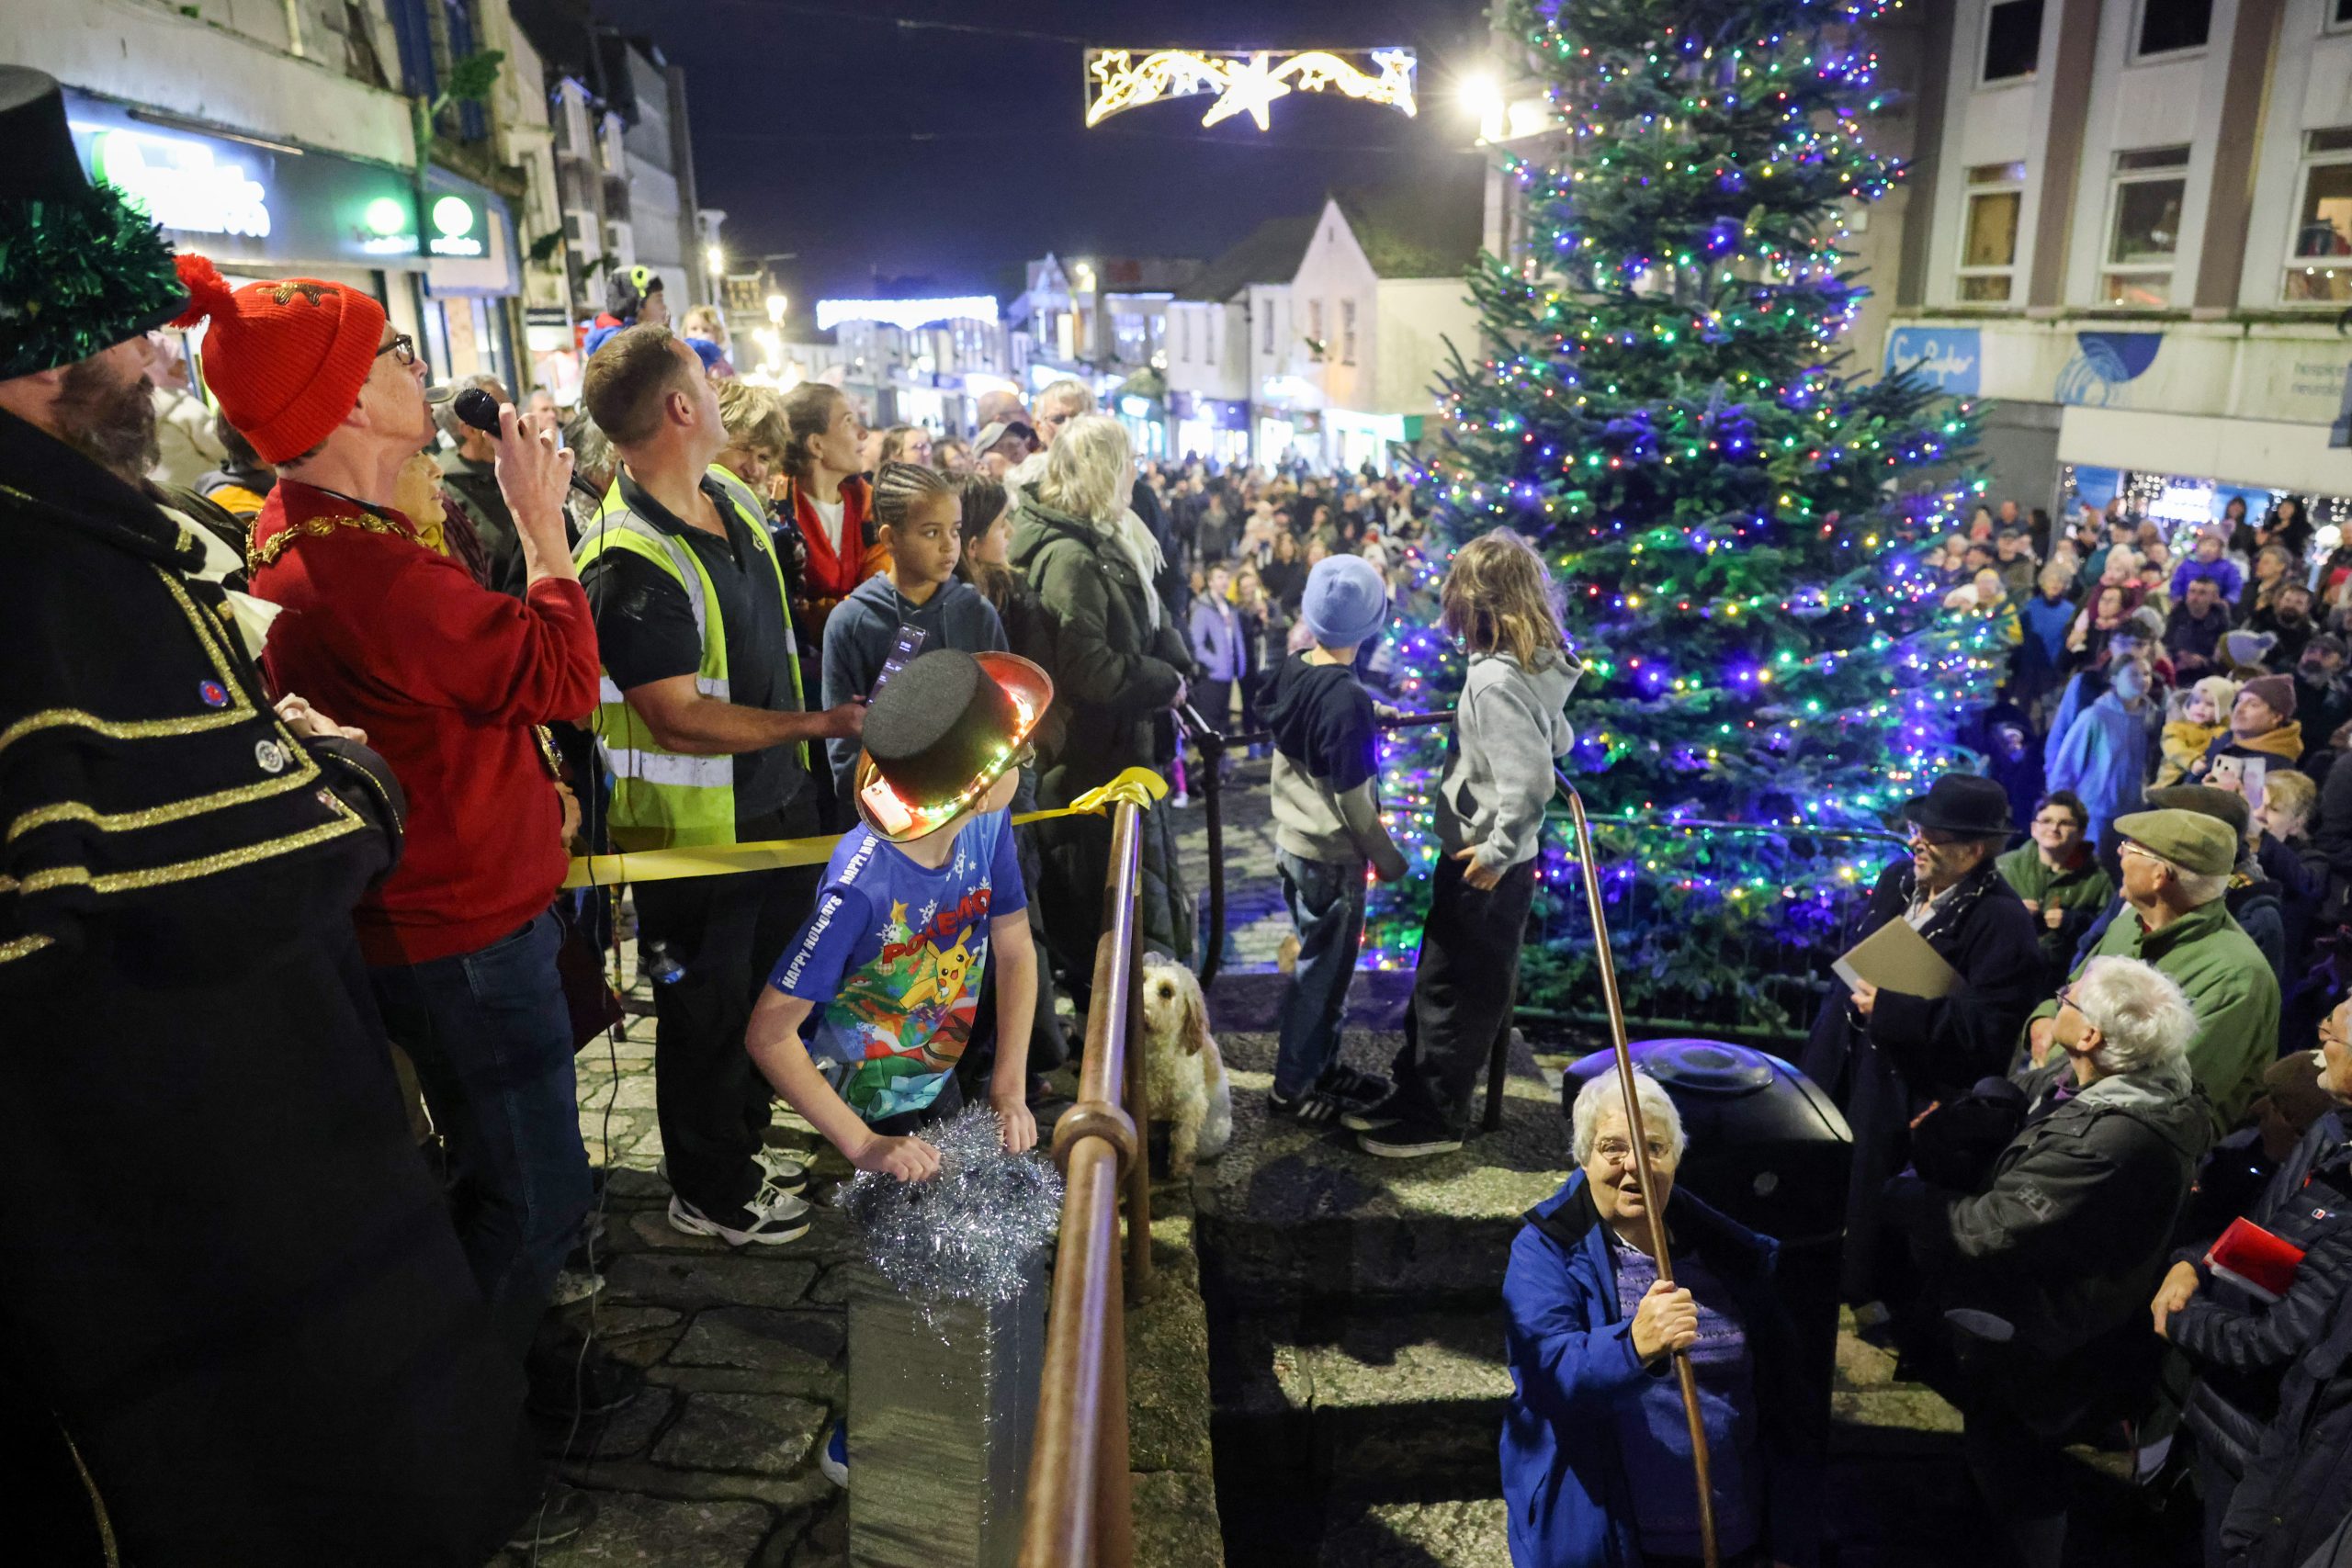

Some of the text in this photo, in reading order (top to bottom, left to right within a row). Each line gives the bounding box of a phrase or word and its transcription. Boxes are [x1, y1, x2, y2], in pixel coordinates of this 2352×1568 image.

[838, 852, 867, 885] HAPPY
[782, 895, 842, 989] HAPPY HOLIDAYS
